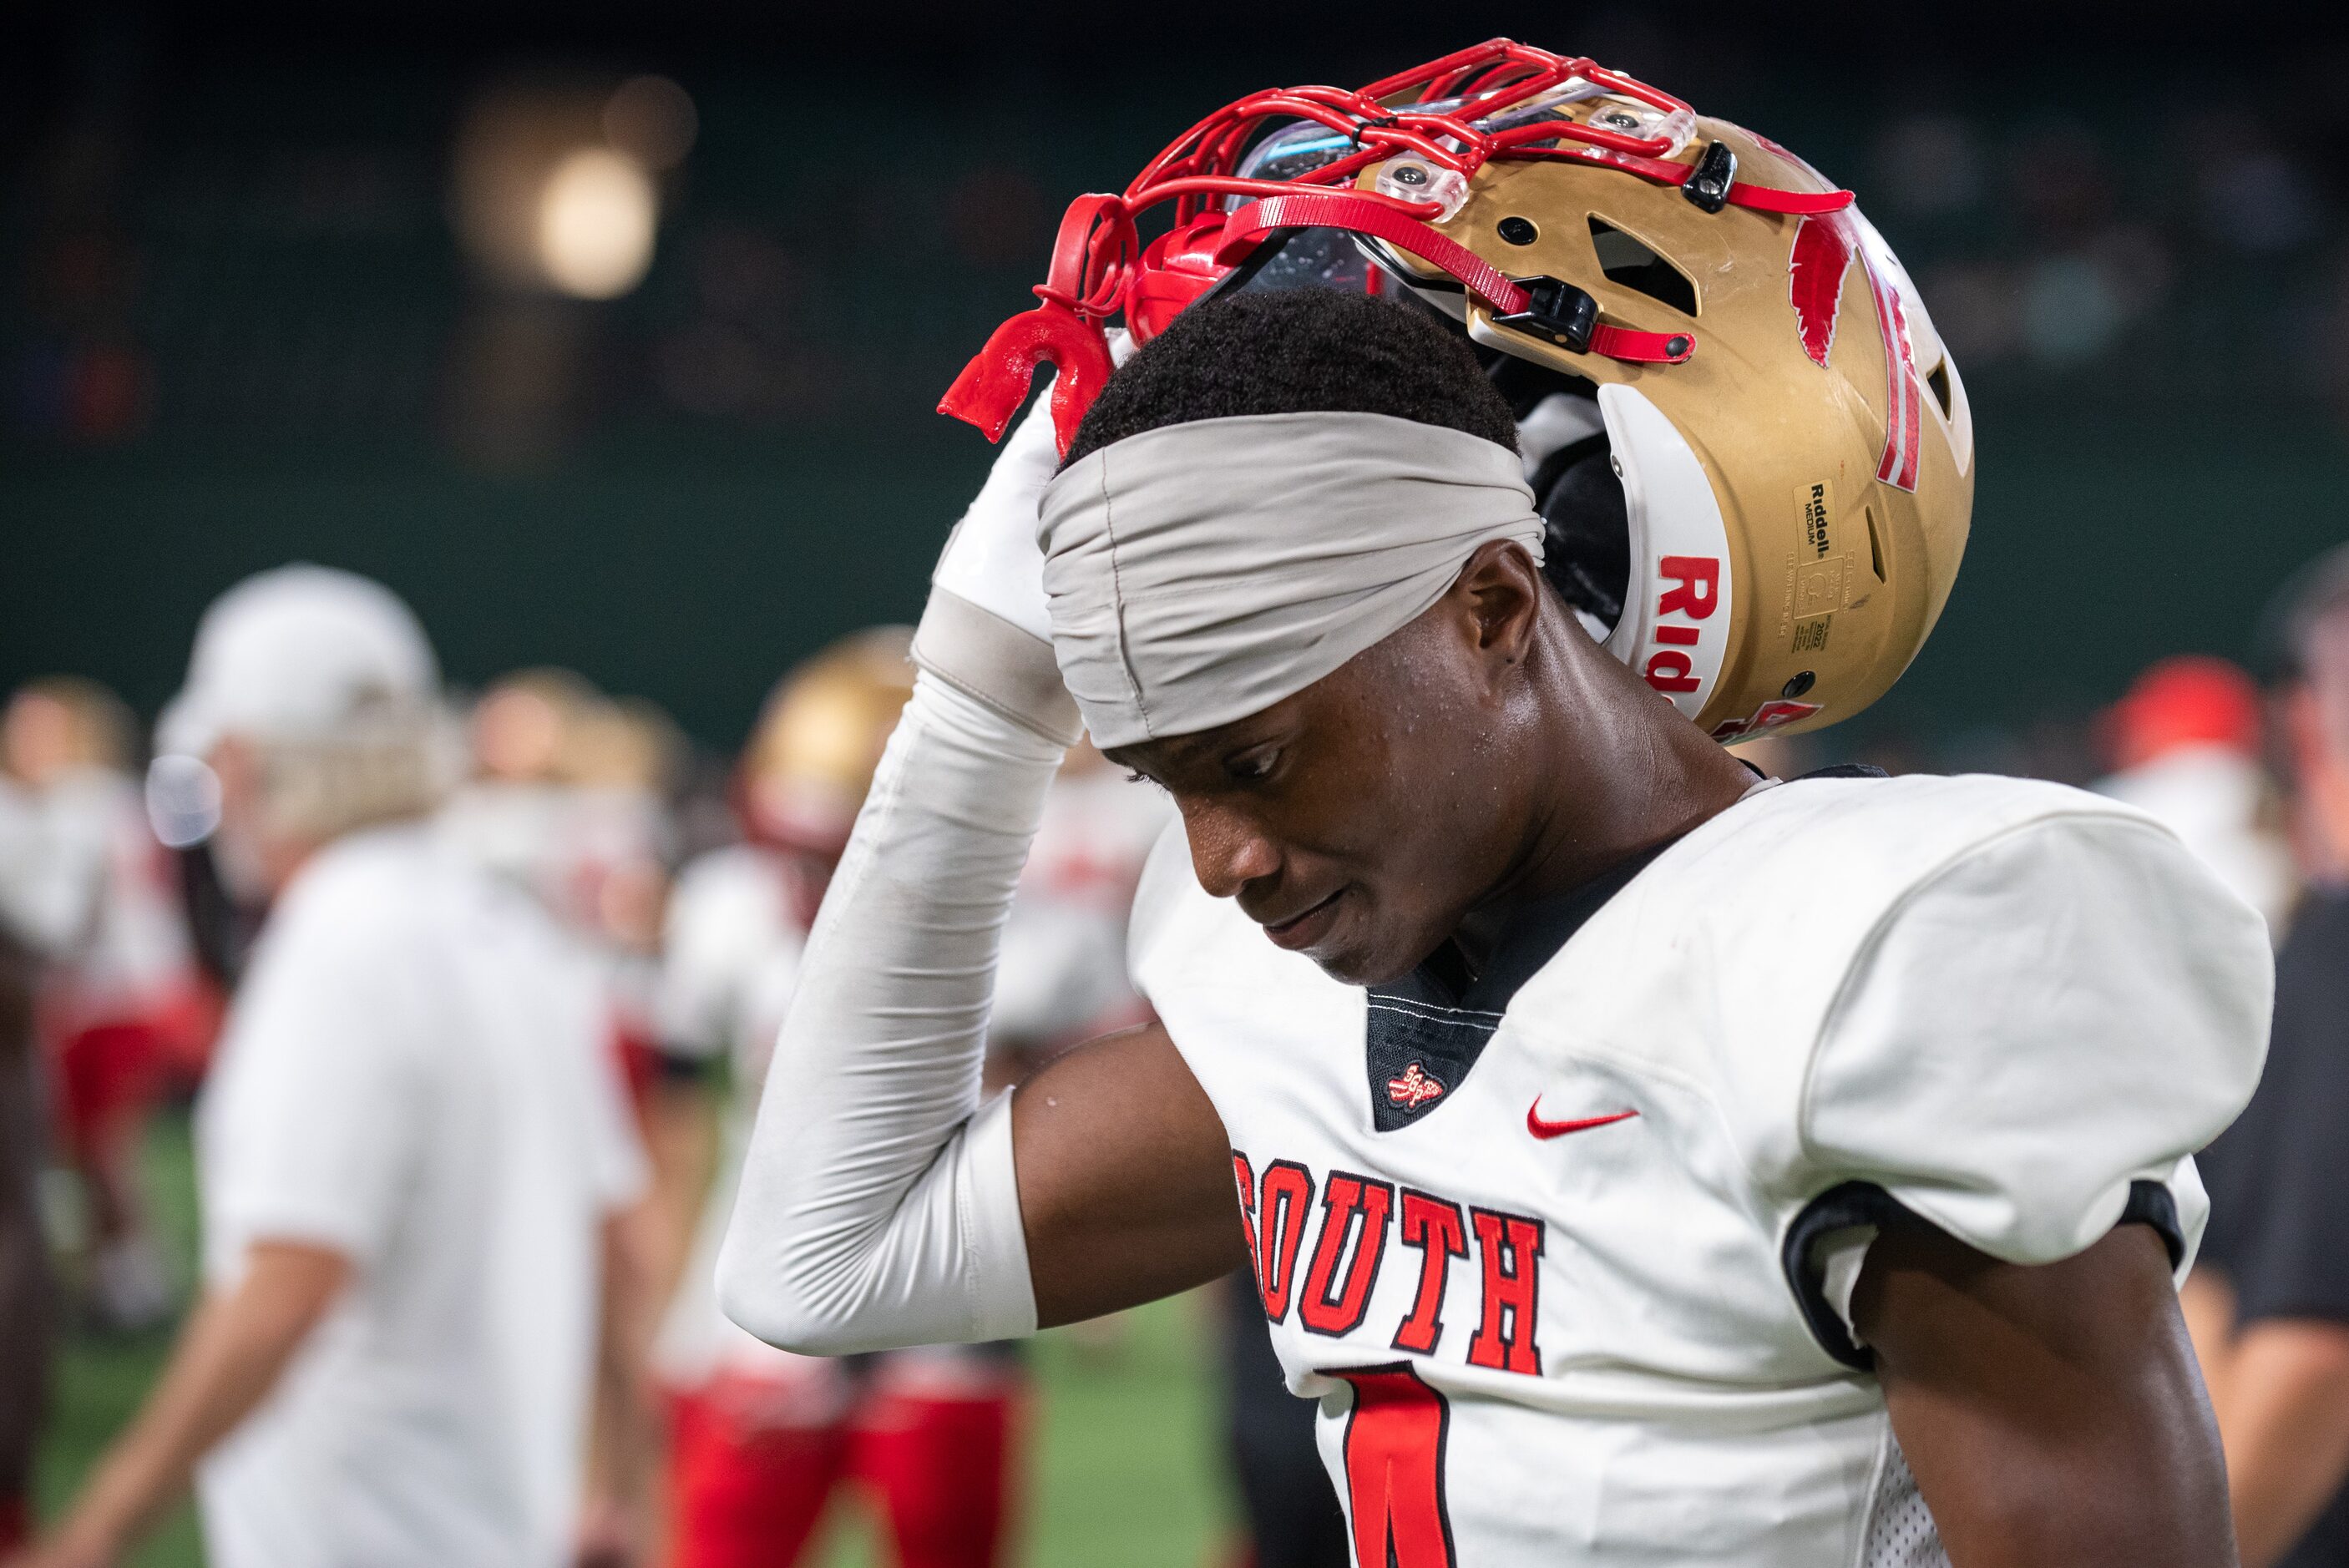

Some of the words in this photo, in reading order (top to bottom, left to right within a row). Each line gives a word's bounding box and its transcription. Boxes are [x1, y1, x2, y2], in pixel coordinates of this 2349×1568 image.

[1805, 503, 1815, 545] MEDIUM
[1811, 483, 1830, 553] Riddell
[1643, 554, 1720, 706] Rid
[1813, 622, 1825, 648] 2022
